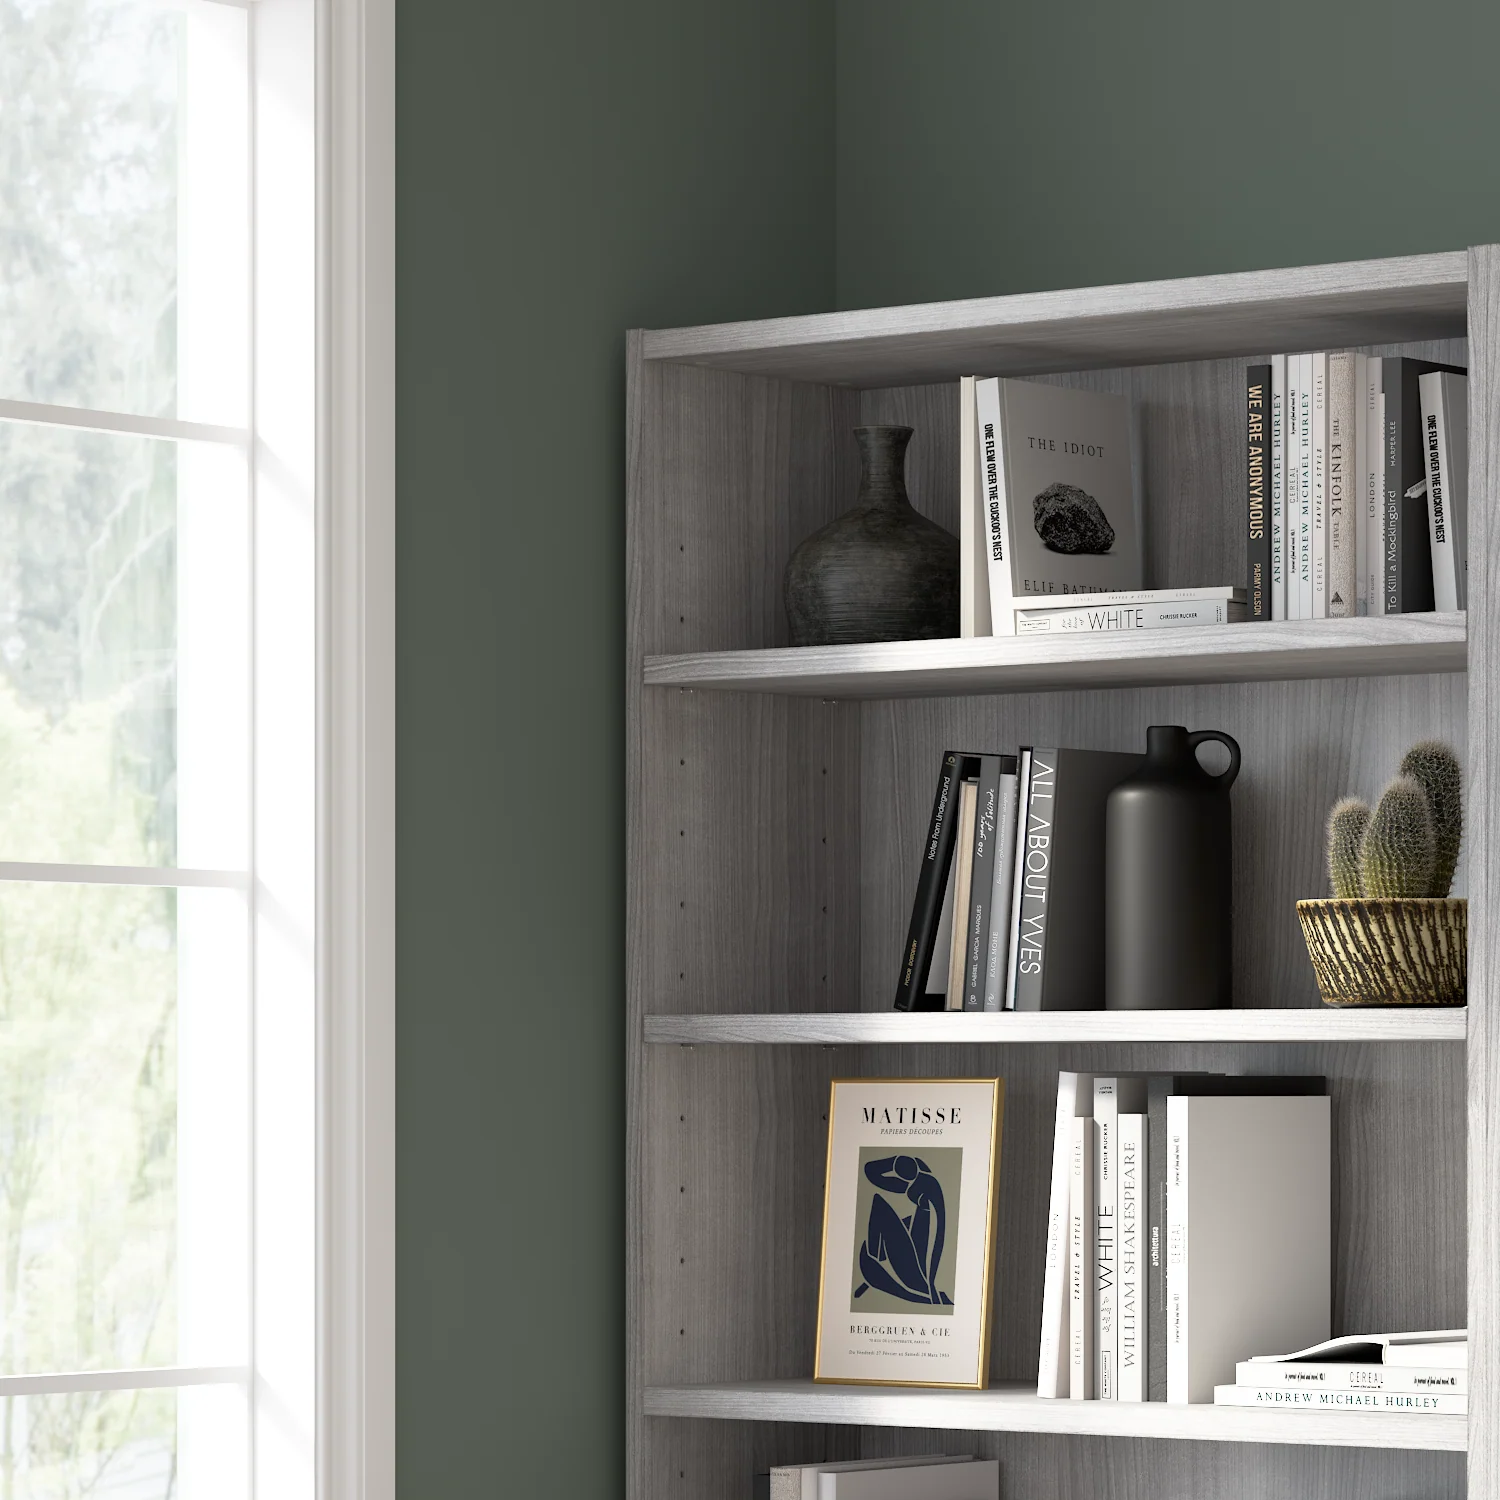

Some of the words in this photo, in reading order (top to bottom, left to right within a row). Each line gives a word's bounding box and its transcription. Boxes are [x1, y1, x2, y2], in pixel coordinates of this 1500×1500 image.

[1248, 385, 1263, 408] WE
[984, 423, 994, 440] ONE
[1249, 412, 1263, 441] ARE
[985, 441, 996, 462] FLEW
[1028, 437, 1055, 451] THE
[1064, 442, 1104, 457] IDIOT
[987, 463, 998, 484] OVER
[988, 485, 999, 501] THE
[1249, 447, 1263, 539] ANONYMOUS
[989, 502, 1001, 541] CUCKOO'S
[992, 541, 1003, 562] NEST
[1024, 580, 1054, 592] ELIF
[1253, 564, 1261, 590] PARMY
[1253, 593, 1261, 615] OLSON
[1088, 609, 1143, 629] WHITE
[1030, 759, 1054, 805] ALL
[935, 776, 951, 817] Underground
[985, 788, 994, 819] Solitude
[933, 817, 943, 838] From
[927, 838, 939, 860] Notes
[1024, 813, 1051, 903] ABOUT
[1019, 914, 1045, 975] YVES
[861, 1107, 962, 1124] MATISSE
[1124, 1142, 1135, 1275] SHAKESPEARE
[1098, 1205, 1114, 1291] WHITE
[850, 1325, 915, 1336] BERGGRUEN
[931, 1327, 950, 1337] CIE
[1124, 1278, 1135, 1368] WILLIAM
[1256, 1393, 1313, 1402] ANDREW
[1319, 1394, 1379, 1405] MICHAEL
[1386, 1397, 1439, 1408] HURLEY
